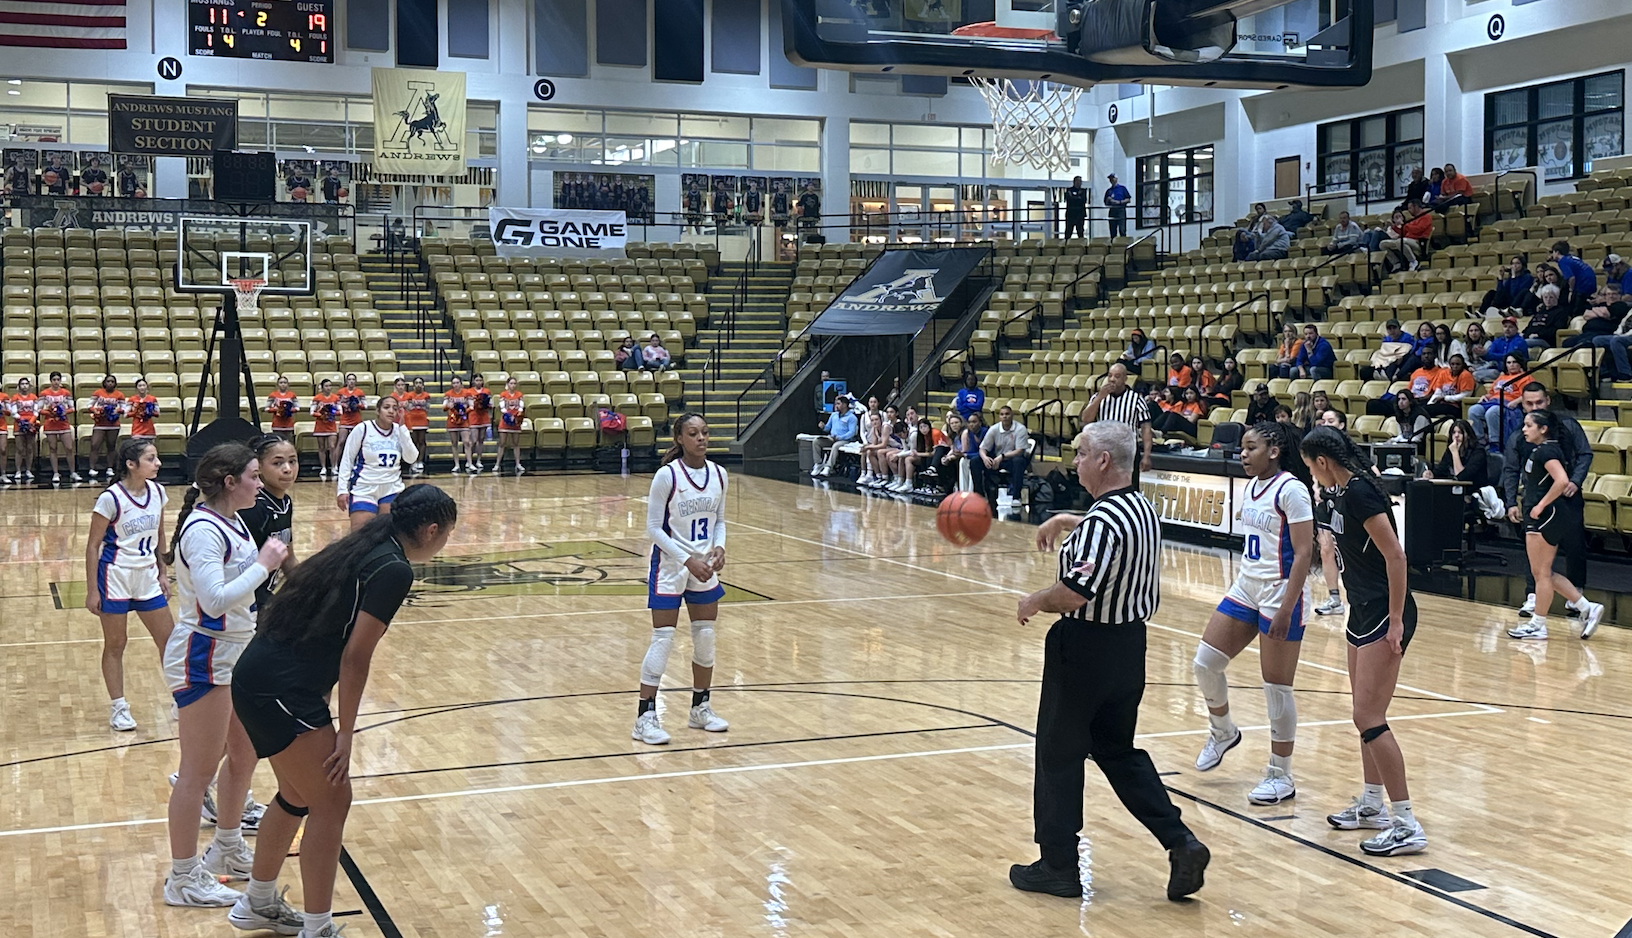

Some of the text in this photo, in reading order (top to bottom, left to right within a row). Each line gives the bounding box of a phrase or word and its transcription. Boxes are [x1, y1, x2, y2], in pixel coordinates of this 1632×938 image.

[251, 2, 272, 10] PERIOD
[296, 2, 325, 12] GUEST
[210, 7, 228, 25] 11
[256, 11, 268, 27] 2
[308, 14, 326, 32] 19
[195, 25, 214, 33] FOULS
[242, 28, 282, 38] PLAYER FOUL
[1490, 18, 1502, 36] Q
[207, 33, 213, 47] 1
[222, 34, 234, 48] 4
[290, 38, 301, 52] 4
[320, 40, 326, 54] 1
[251, 52, 273, 60] MATCH
[308, 55, 327, 63] SCORE
[163, 60, 177, 76] N
[538, 82, 552, 97] O
[113, 102, 234, 116] ANDREWS MUSTANG
[131, 117, 217, 133] STUDENT
[134, 135, 213, 151] SECTION
[379, 152, 461, 161] ANDREWS
[91, 211, 174, 224] ANDREWS
[539, 220, 626, 237] GAME
[540, 235, 602, 249] ONE
[831, 302, 942, 312] ANDREWS
[1156, 472, 1172, 480] HOME
[1180, 475, 1191, 483] THE
[1140, 481, 1225, 526] USTANGS
[691, 517, 708, 541] 13
[138, 535, 153, 556] 11
